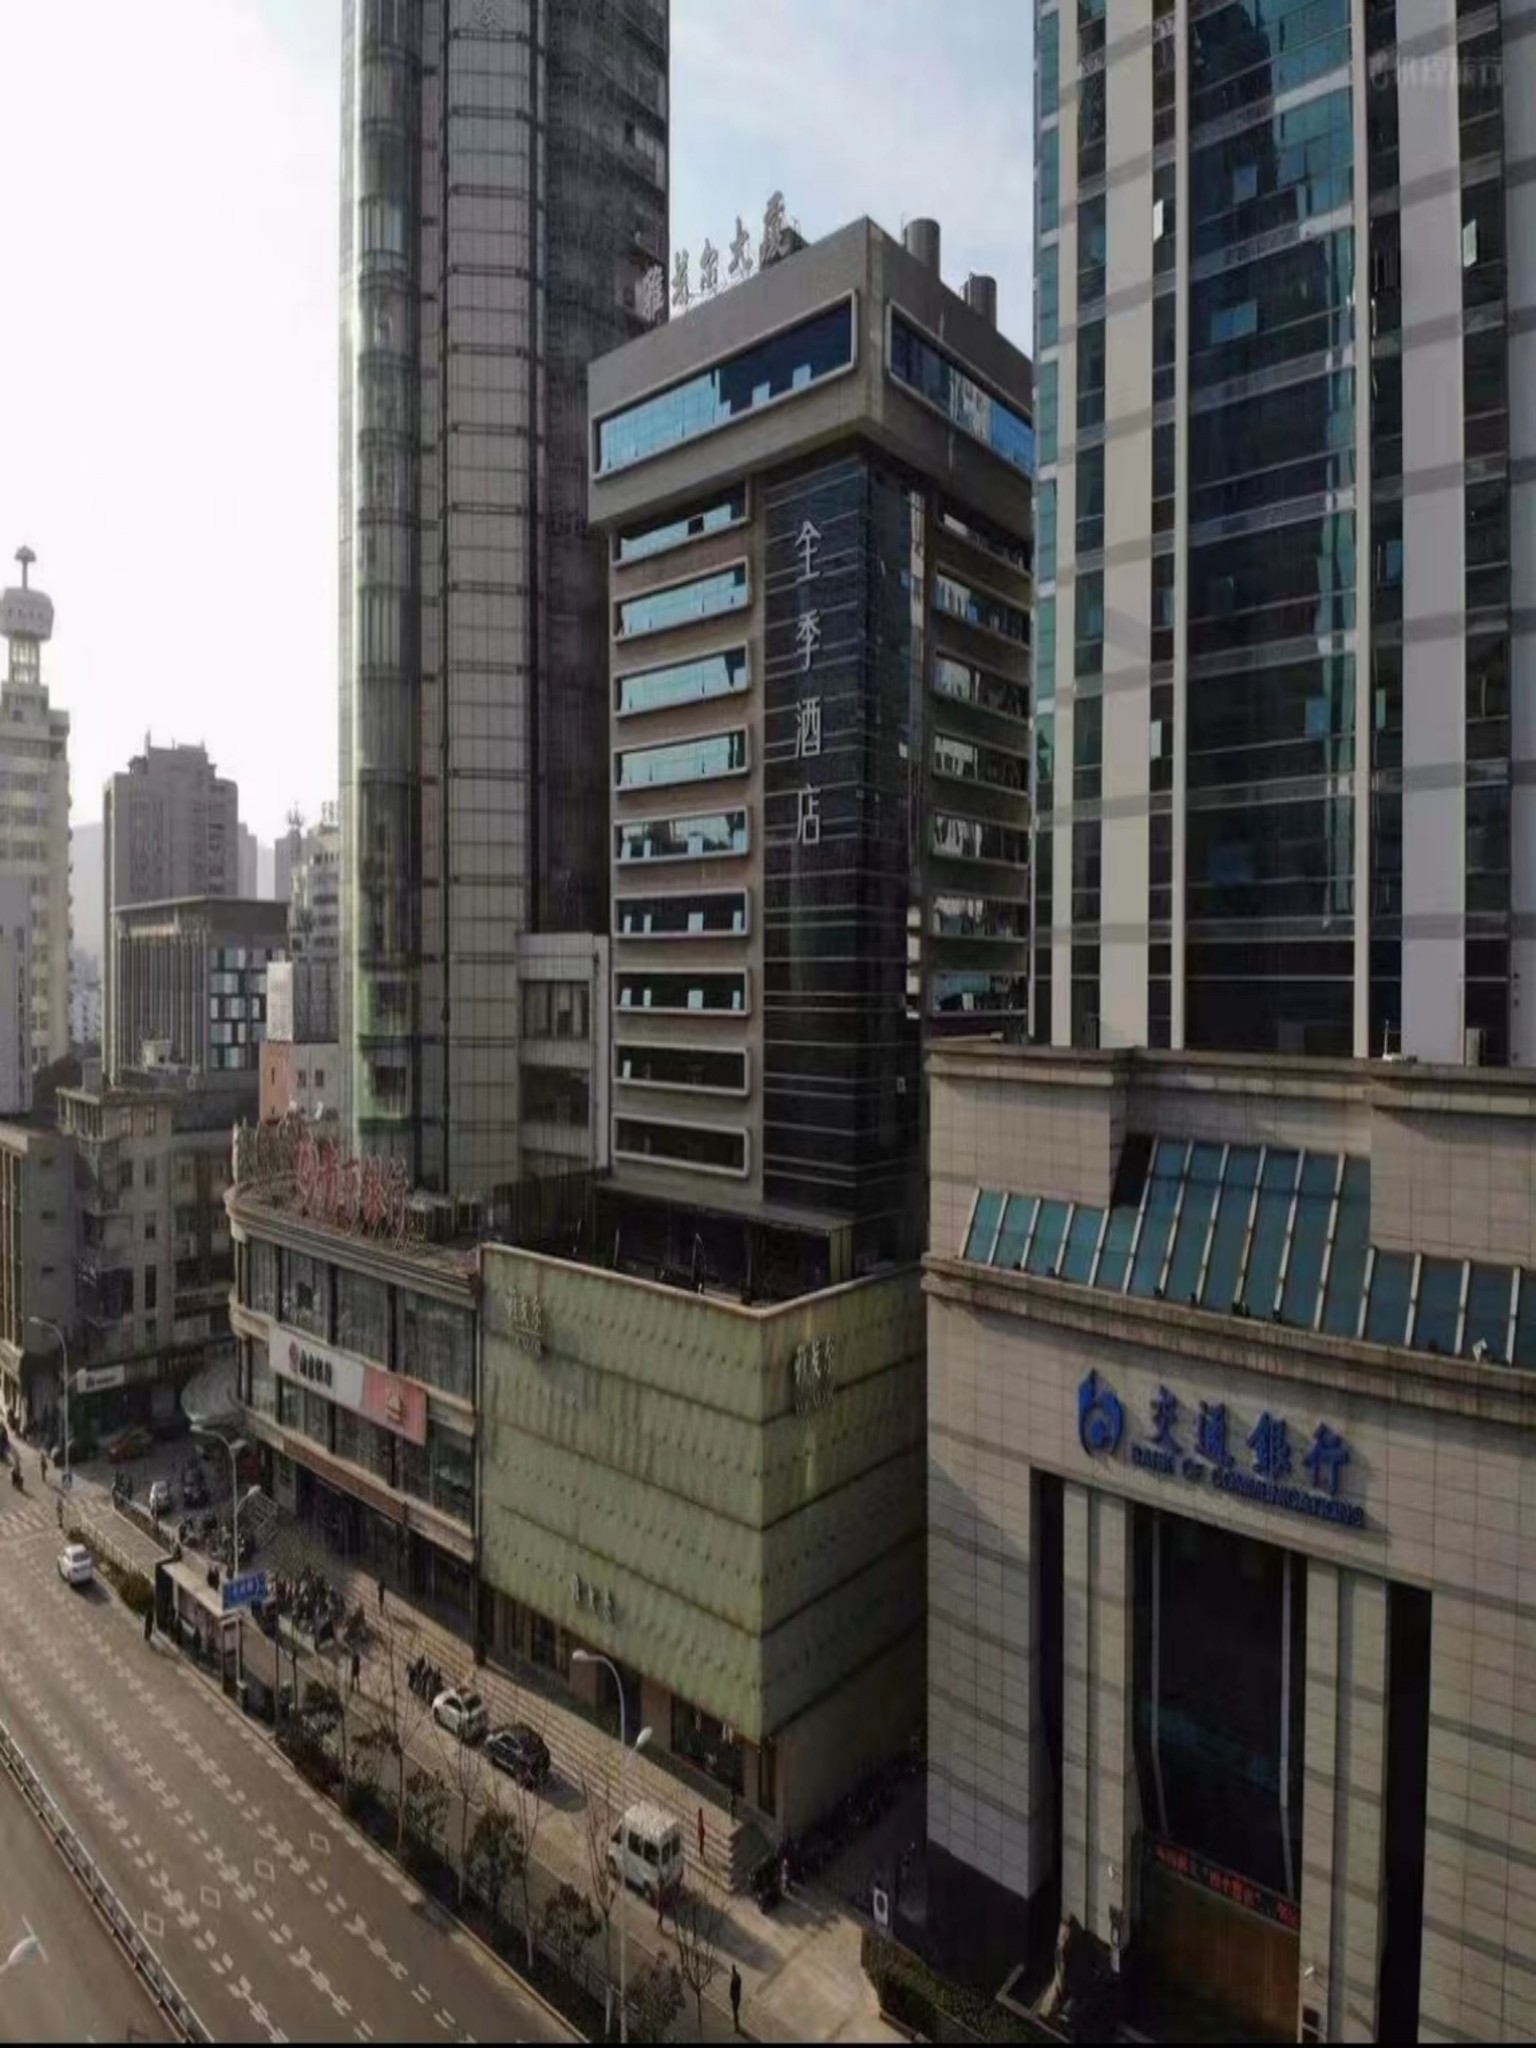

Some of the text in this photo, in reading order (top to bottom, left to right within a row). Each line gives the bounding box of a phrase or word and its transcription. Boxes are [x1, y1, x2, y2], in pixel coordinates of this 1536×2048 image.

[795, 520, 822, 845] 全季酒店
[1131, 1443, 1366, 1527] BANK OF COMMUNICATIONS
